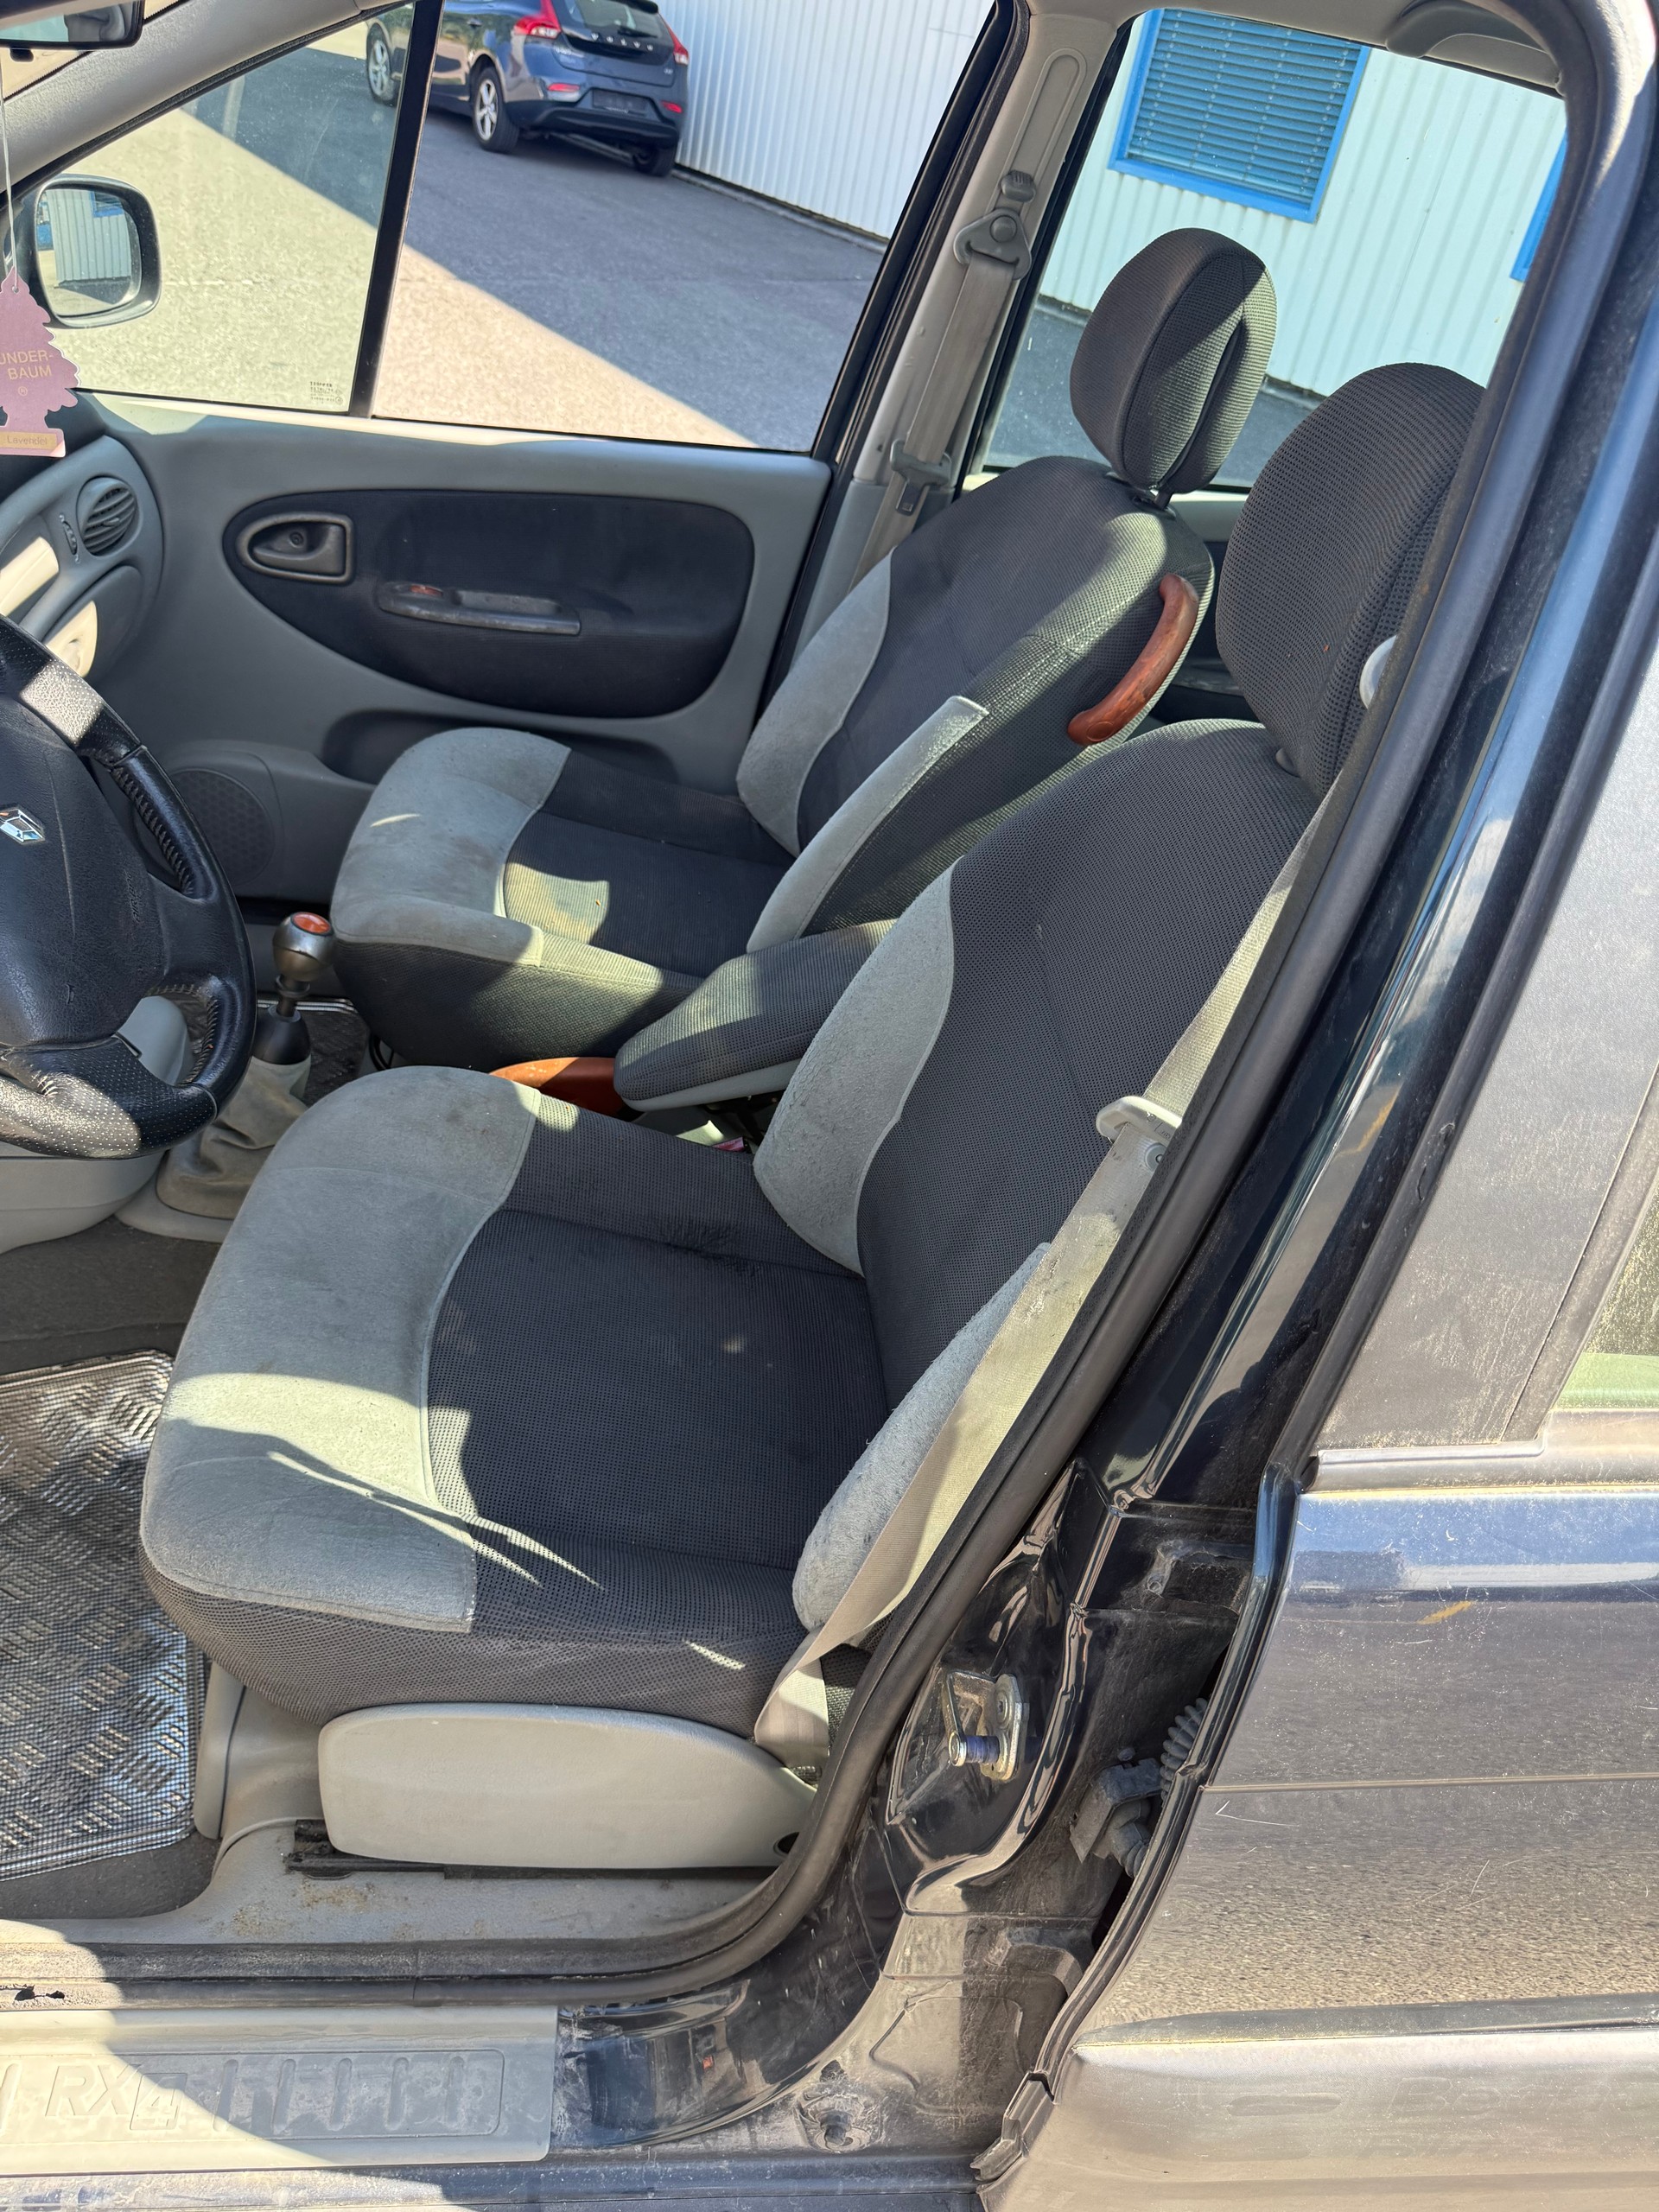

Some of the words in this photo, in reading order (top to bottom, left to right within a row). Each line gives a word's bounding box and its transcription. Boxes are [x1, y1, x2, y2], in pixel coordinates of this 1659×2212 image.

[592, 32, 653, 51] VOLVO
[8, 365, 52, 380] BAUM
[7, 435, 48, 445] Lavendel
[45, 2063, 188, 2131] RX4
